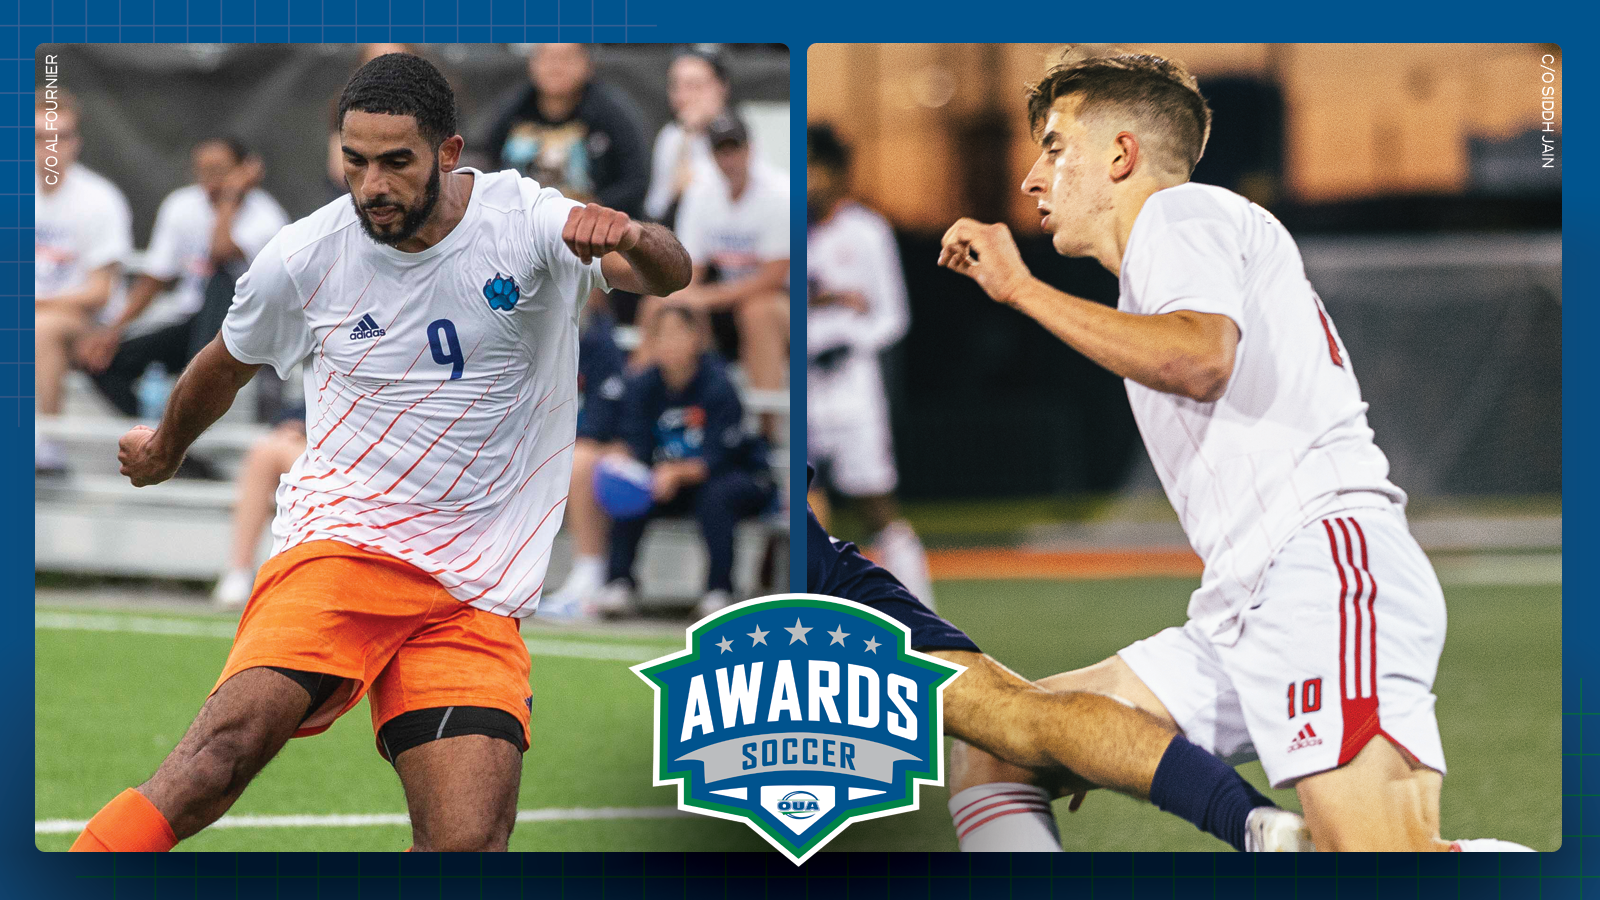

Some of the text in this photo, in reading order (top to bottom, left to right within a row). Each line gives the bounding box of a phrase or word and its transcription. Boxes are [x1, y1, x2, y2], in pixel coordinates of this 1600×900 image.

[349, 328, 386, 340] adidas
[426, 318, 465, 380] 9
[1286, 677, 1322, 719] 10
